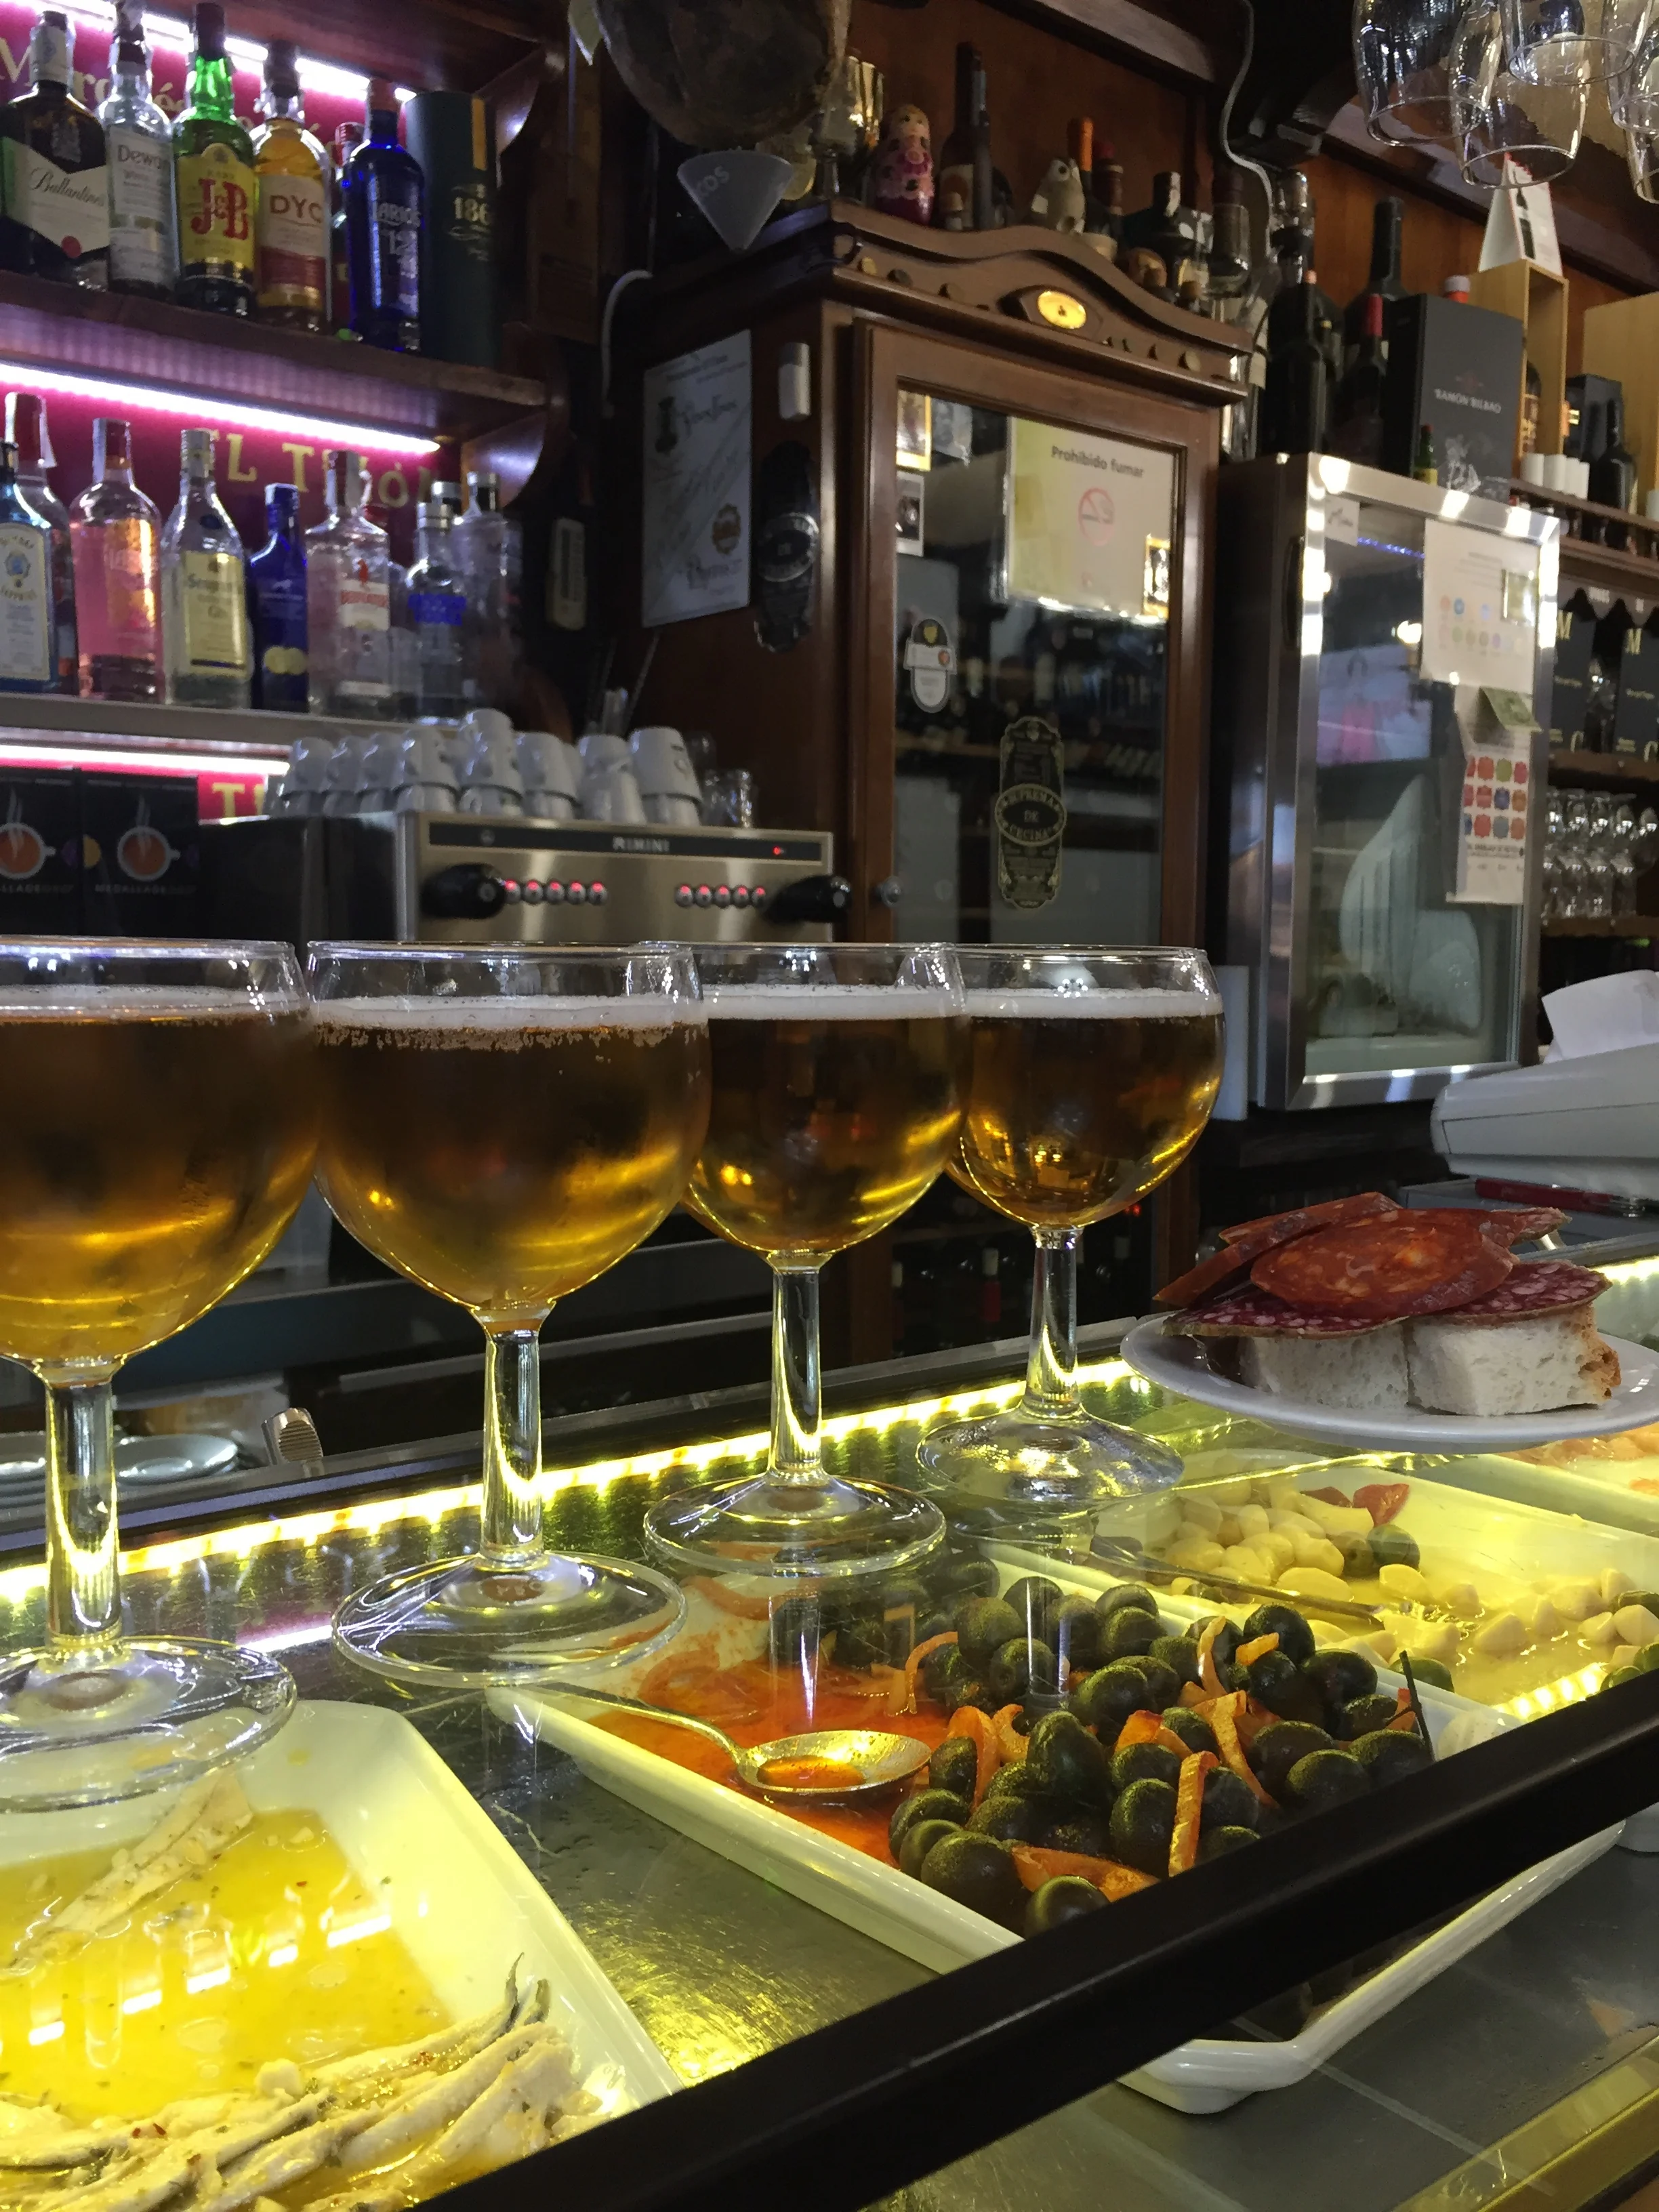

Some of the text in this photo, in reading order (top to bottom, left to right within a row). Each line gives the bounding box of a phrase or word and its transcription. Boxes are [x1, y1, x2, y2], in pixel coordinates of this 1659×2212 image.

[190, 178, 249, 241] J&B
[270, 194, 323, 224] DYC
[1050, 445, 1144, 478] Prohibido fumar
[612, 836, 670, 852] RIMINI
